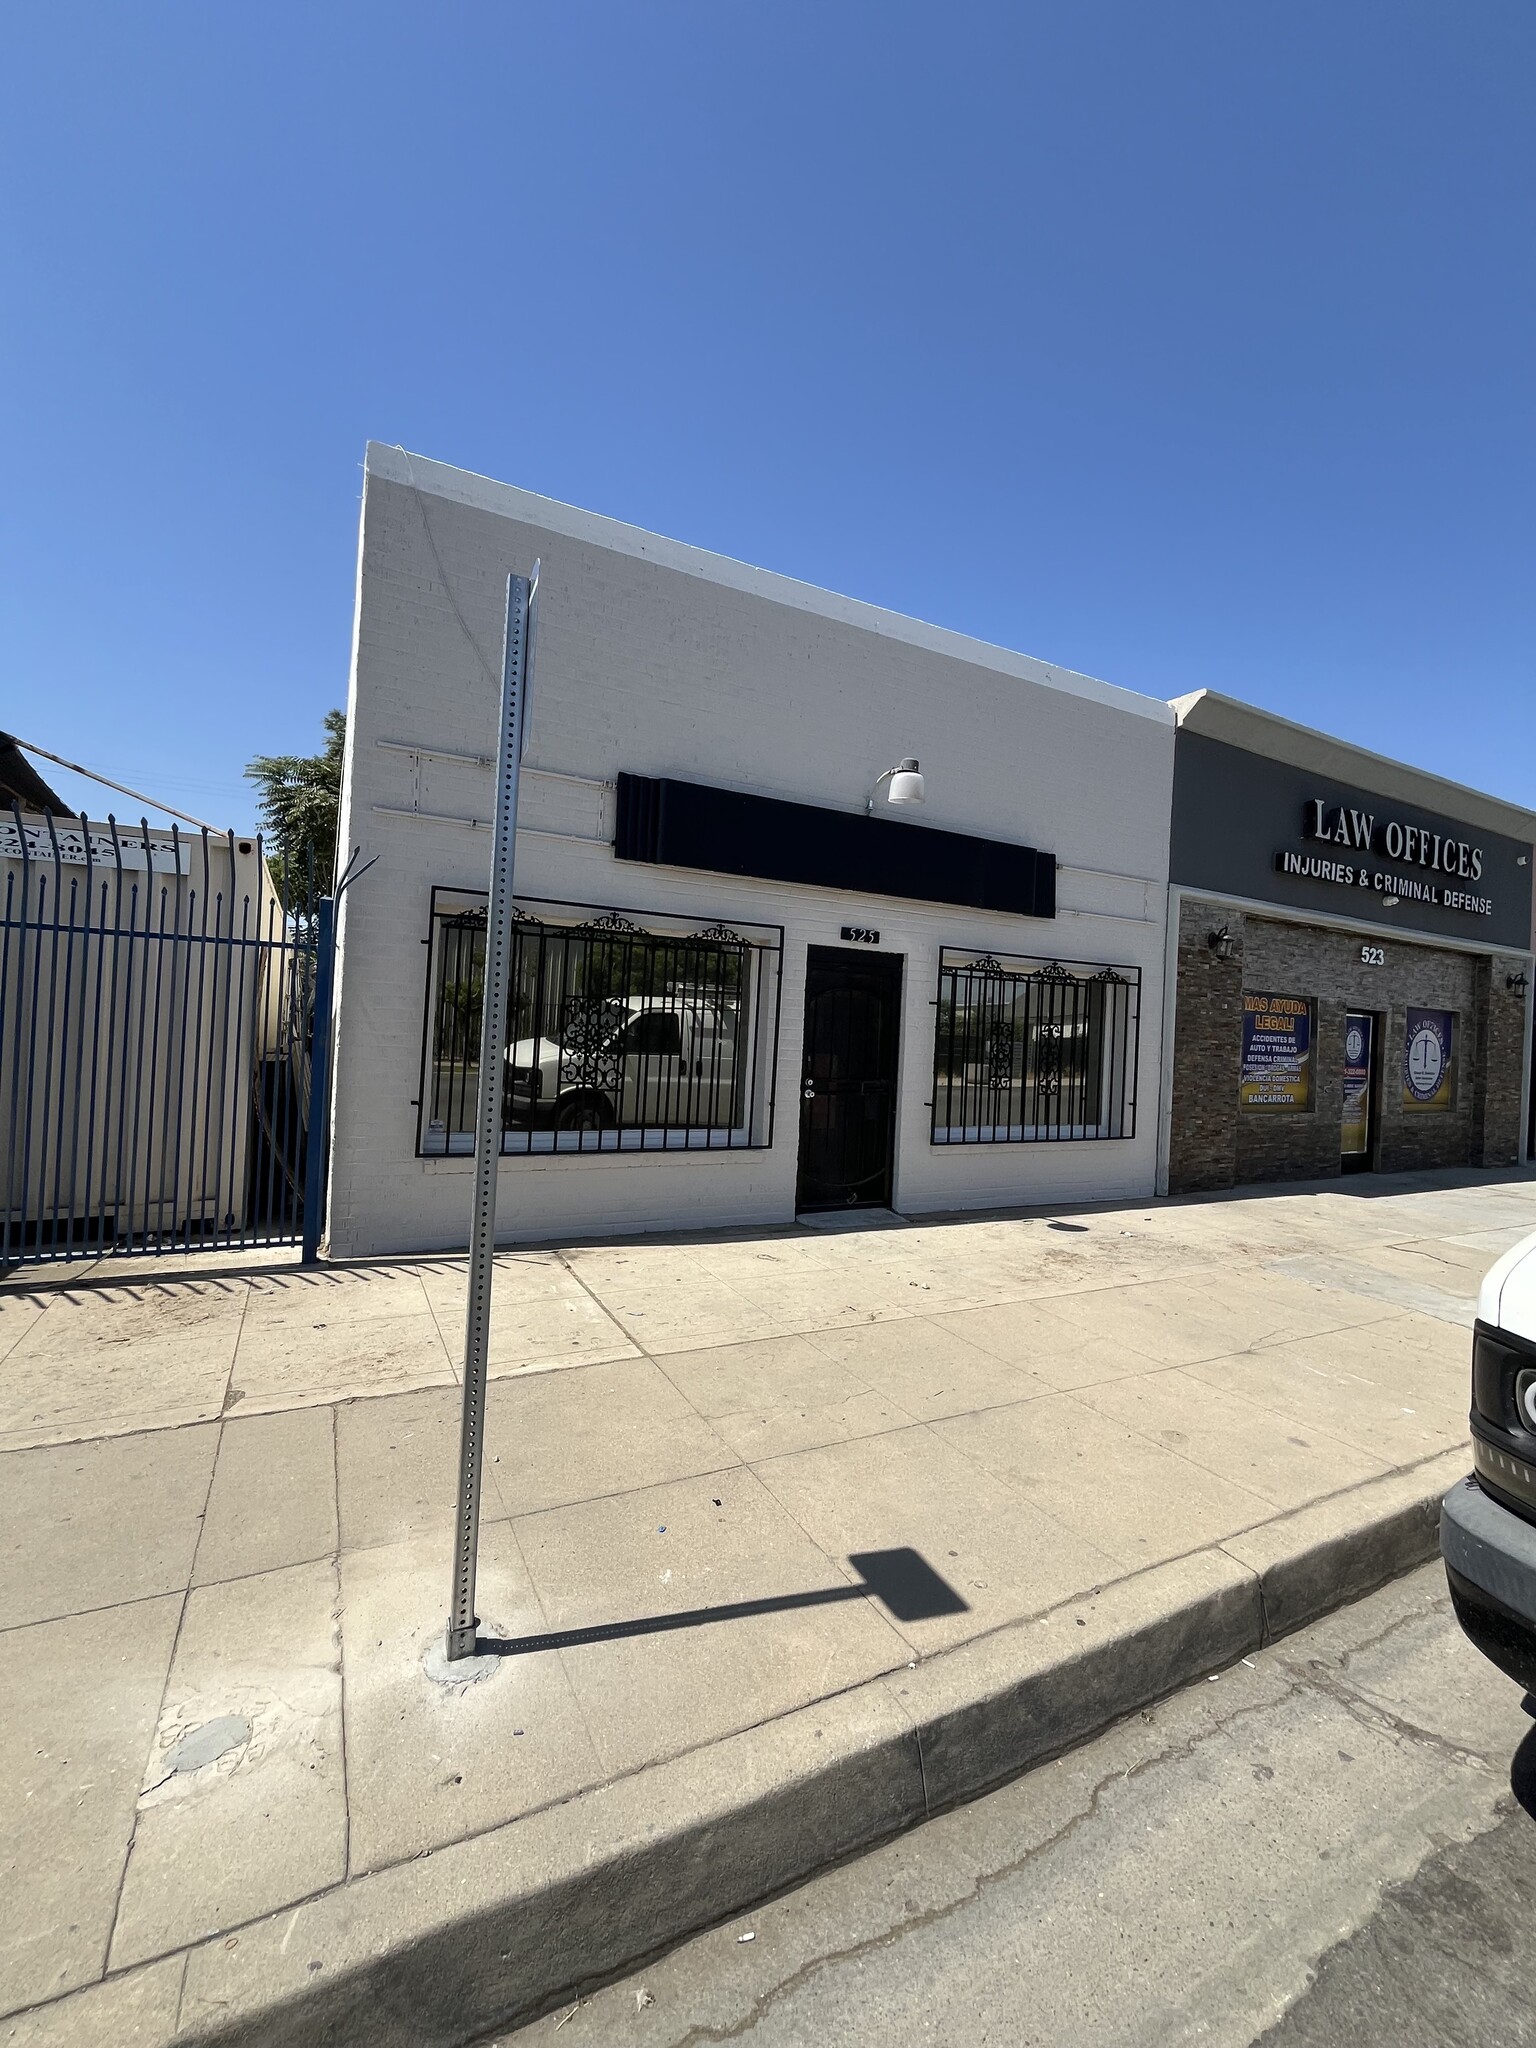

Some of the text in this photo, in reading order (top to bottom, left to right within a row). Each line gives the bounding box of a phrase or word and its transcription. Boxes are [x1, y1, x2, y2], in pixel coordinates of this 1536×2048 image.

[1314, 799, 1483, 881] LAW OFFICES
[1283, 851, 1492, 916] INJURIES & CRIMINAL DEFENSE
[850, 928, 876, 944] 525
[1361, 946, 1385, 966] 523
[1244, 996, 1307, 1016] MAS AYUDA
[1255, 1014, 1295, 1032] LEGAL!
[1252, 1034, 1296, 1044] ACCIDENTES DE
[1250, 1044, 1265, 1052] AUTO
[1272, 1045, 1298, 1053] TRABAJO
[1247, 1054, 1272, 1062] DEFENSA
[1248, 1094, 1294, 1103] BANCARROTA
